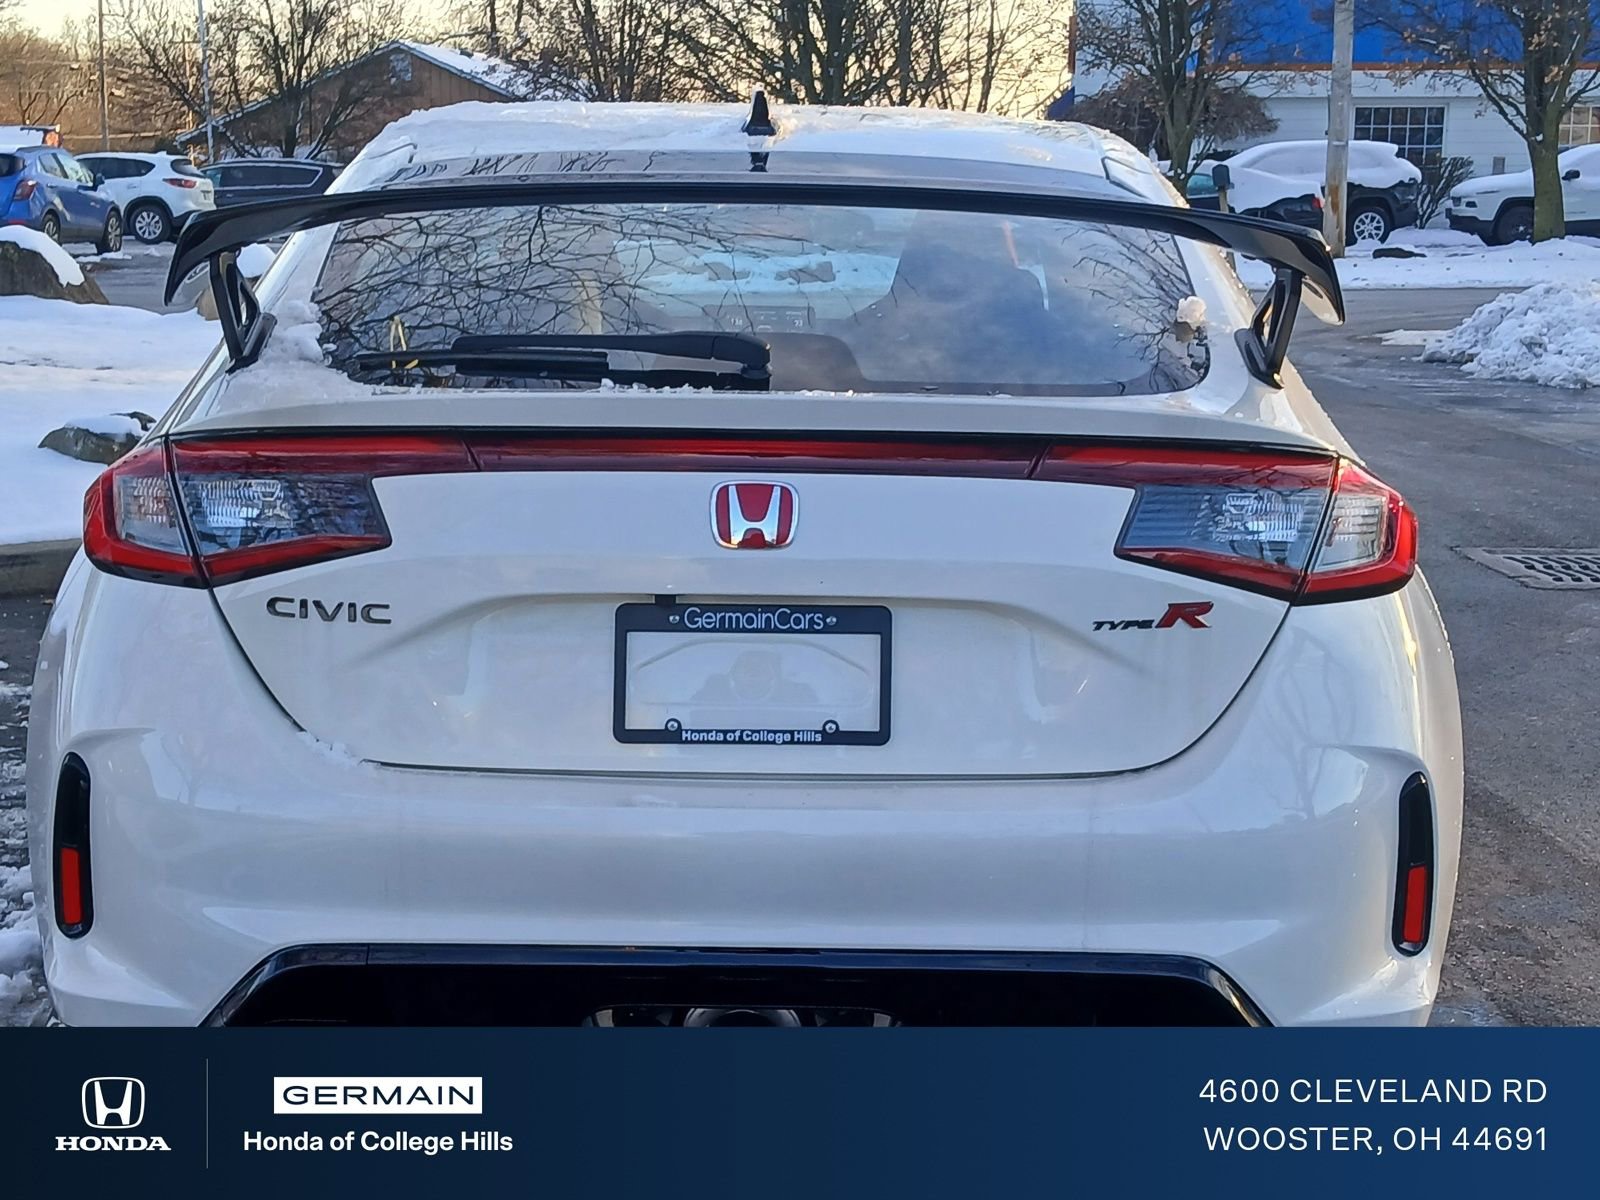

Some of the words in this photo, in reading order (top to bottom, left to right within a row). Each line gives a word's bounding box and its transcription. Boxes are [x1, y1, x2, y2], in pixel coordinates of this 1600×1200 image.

[266, 596, 392, 625] CIVIC
[683, 607, 824, 630] GermainCars
[1092, 619, 1155, 631] TYPE
[1155, 600, 1215, 629] R
[681, 730, 724, 742] Honda
[726, 730, 740, 742] of
[742, 730, 791, 745] College
[793, 731, 822, 742] Hills
